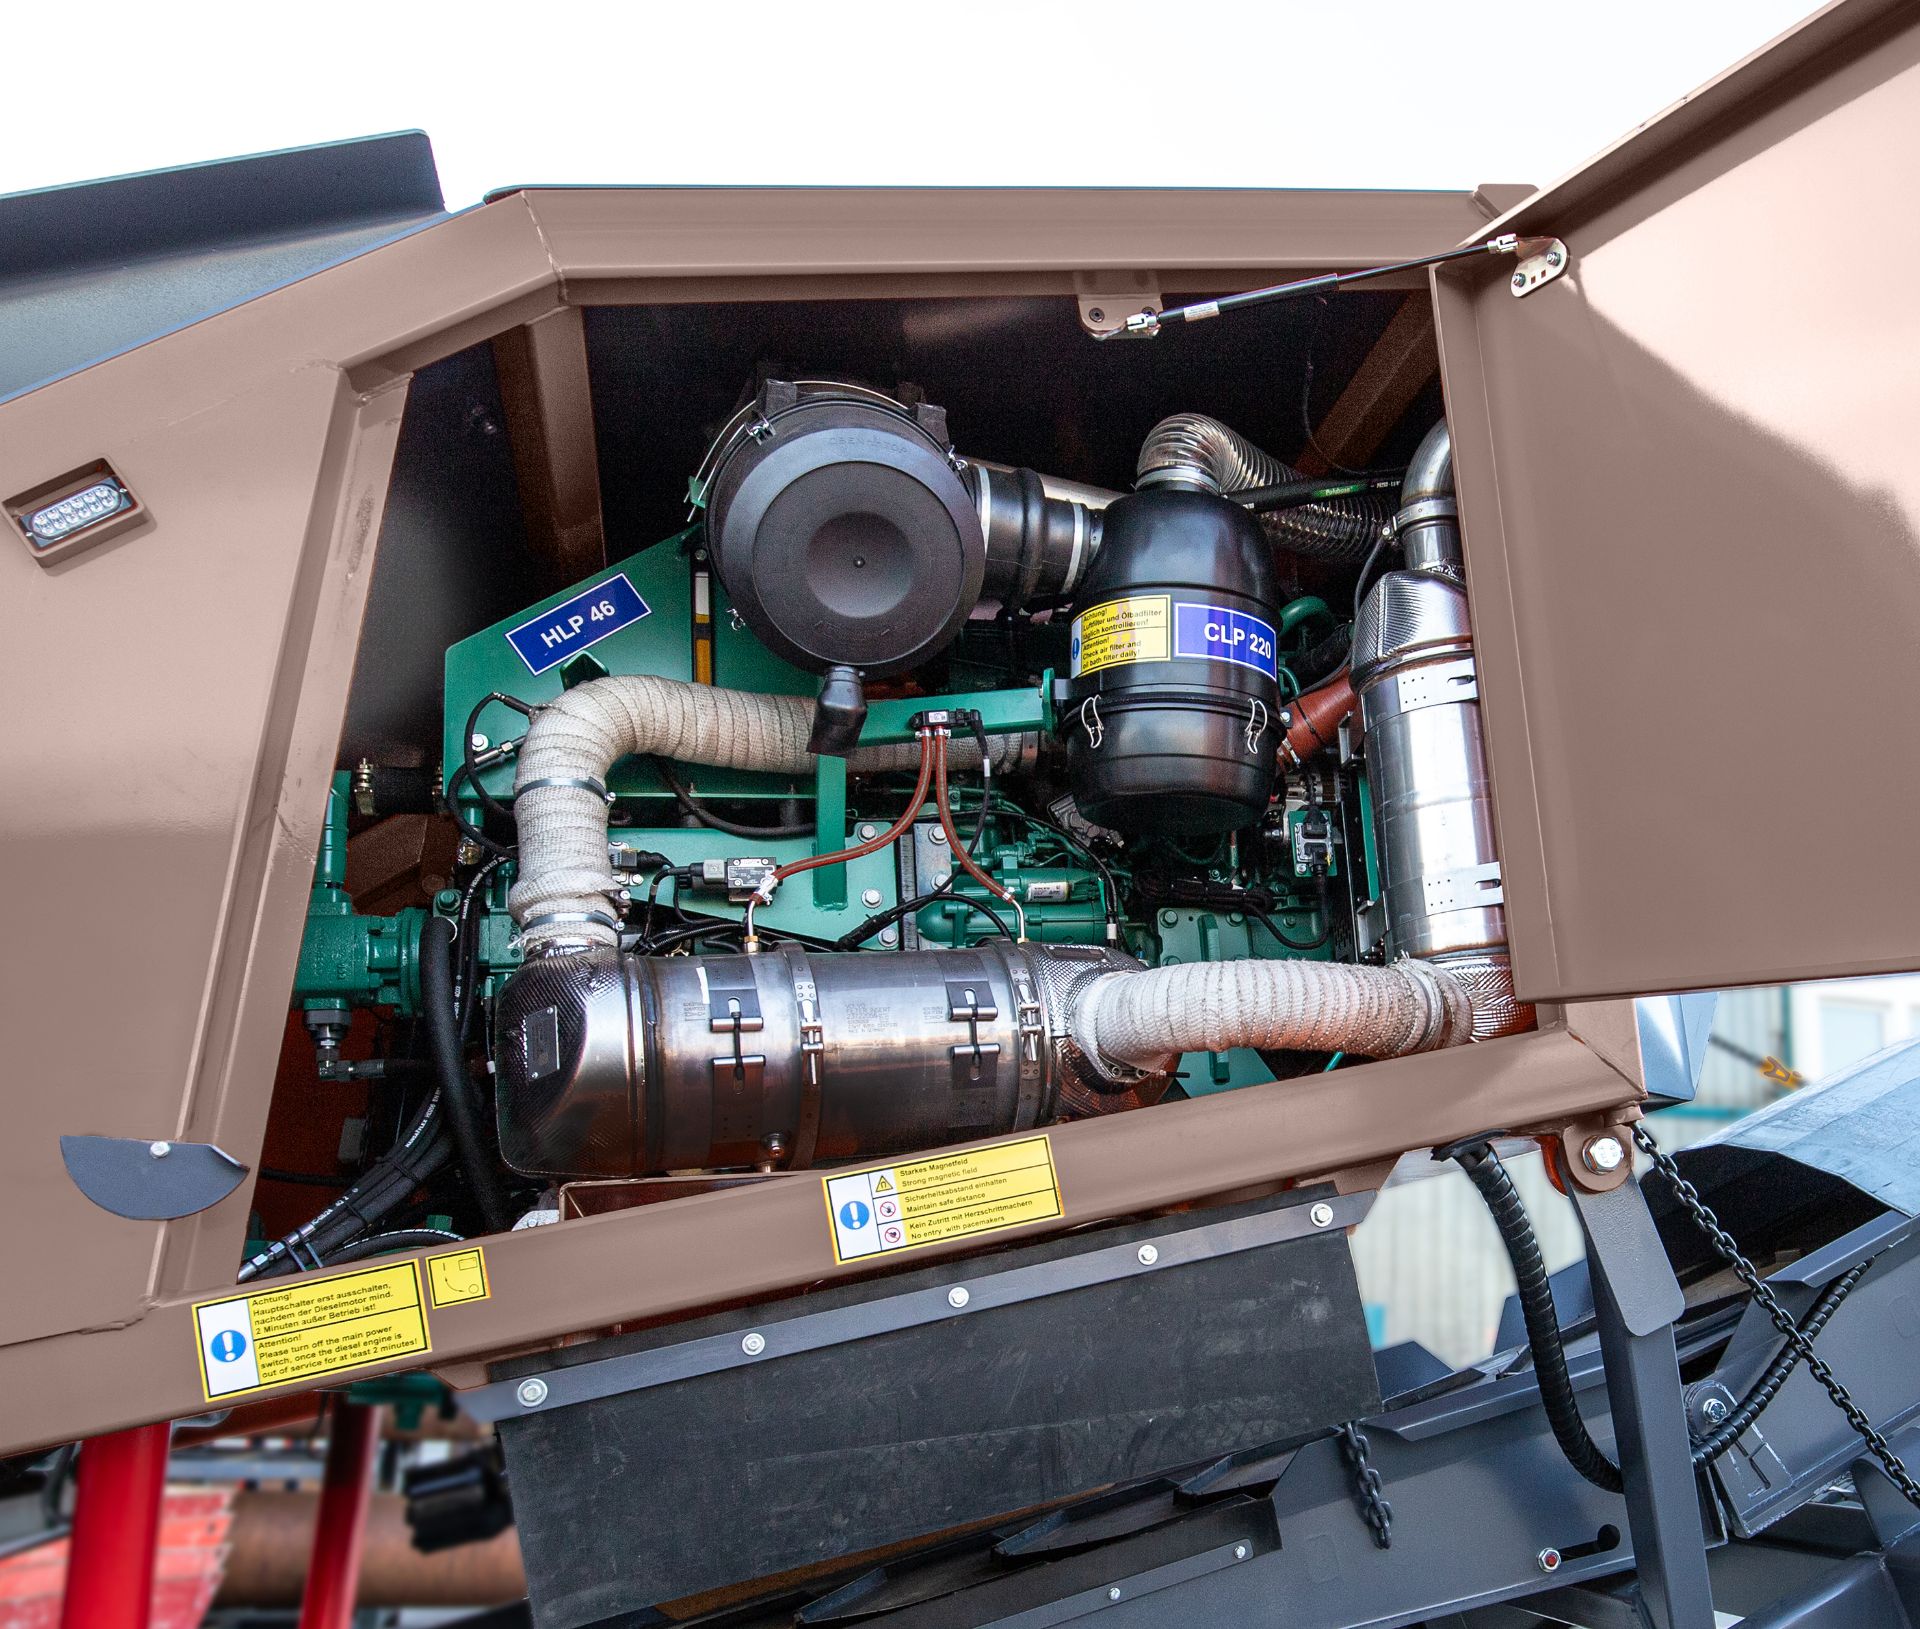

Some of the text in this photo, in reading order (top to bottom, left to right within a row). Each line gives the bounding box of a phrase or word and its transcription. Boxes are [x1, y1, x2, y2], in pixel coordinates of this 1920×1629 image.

[540, 600, 616, 649] HLP 46
[1083, 608, 1107, 621] Achtung!
[1107, 614, 1119, 622] und
[1101, 619, 1149, 633] kontrollieren!
[1083, 636, 1110, 651] Attention!
[1083, 650, 1098, 660] Check
[1109, 643, 1125, 651] filter
[1127, 640, 1141, 648] and
[1204, 623, 1271, 659] CLP 220
[1090, 658, 1102, 666] bath
[1103, 654, 1118, 662] filter
[1120, 650, 1140, 658] daily!
[900, 1158, 968, 1177] Starkes Magnetfeld
[902, 1167, 978, 1187] Strong magnetic field
[905, 1178, 1007, 1203] Sicherheitsabstand einhalten
[906, 1192, 986, 1213] Maintain safe distance
[910, 1200, 1033, 1230] Kein Zutritt mit Herzschrittmachern
[923, 1229, 942, 1239] entry
[962, 1216, 1005, 1230] pacemakers
[252, 1292, 292, 1306] Achtung!
[253, 1283, 391, 1317] Hauptschalter erst ausschalten,
[255, 1291, 393, 1326] nachdem der Dieselmotor mind.
[256, 1303, 376, 1335] 2 Minuten außer Betrieb ist!
[258, 1334, 301, 1349] Attention!
[260, 1326, 392, 1359] Please turn off the main power
[261, 1332, 402, 1370] switch, once the diesel engine is
[262, 1370, 277, 1378] out
[279, 1366, 288, 1375] of
[290, 1360, 322, 1372] service
[324, 1356, 337, 1365] for
[339, 1354, 347, 1362] at
[350, 1348, 371, 1359] least
[381, 1338, 417, 1352] minutes!
